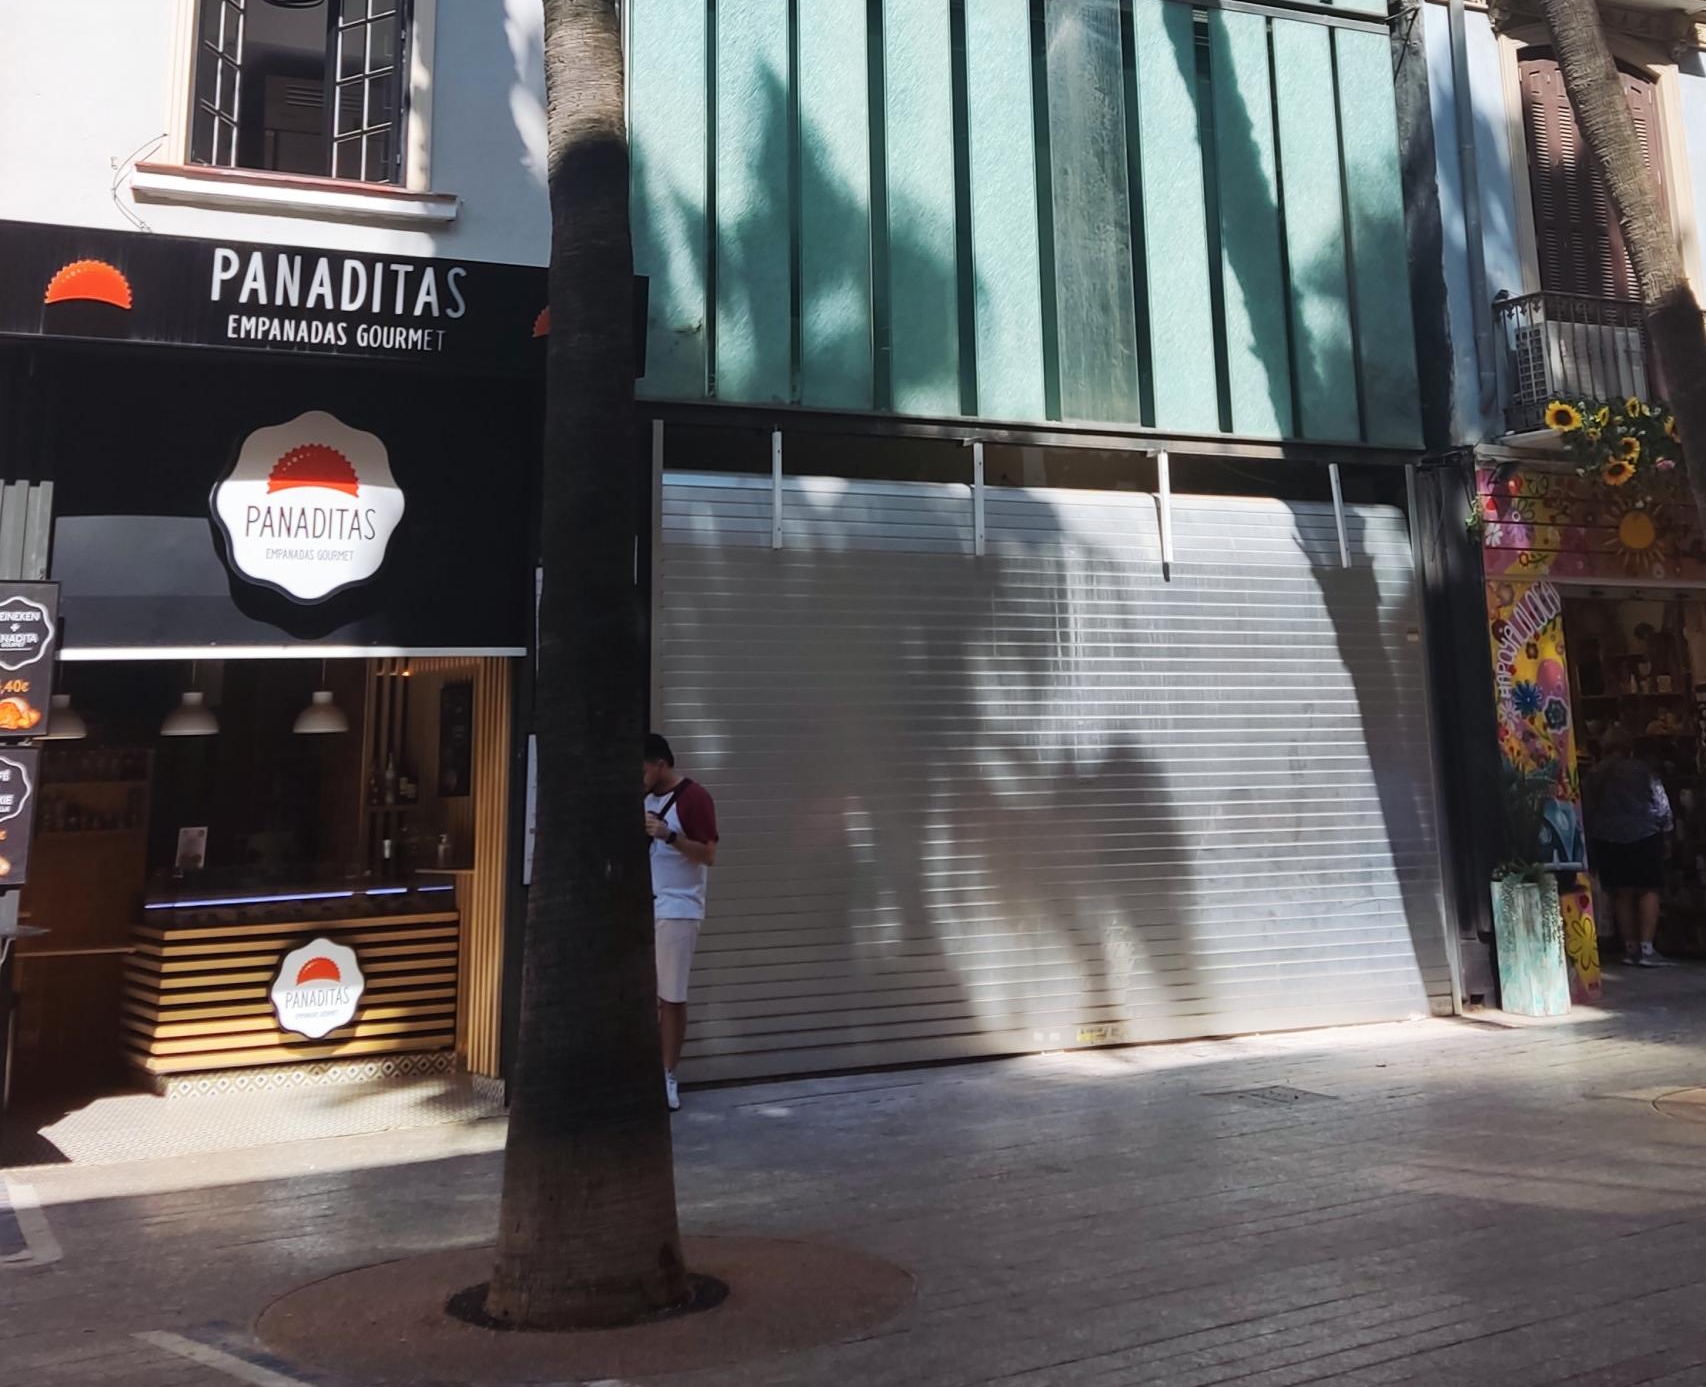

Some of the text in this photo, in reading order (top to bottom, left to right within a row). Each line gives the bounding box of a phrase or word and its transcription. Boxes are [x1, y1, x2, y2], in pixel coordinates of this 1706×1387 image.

[211, 247, 467, 318] PANADITAS
[227, 315, 447, 351] EMPANADAS GOURMET
[245, 505, 377, 540] PANADITAS
[265, 548, 354, 561] EMPANADAS GOURMET
[0, 611, 41, 622] EINEKEN
[0, 633, 39, 644] NADITA
[285, 987, 350, 1009] PANADITAS
